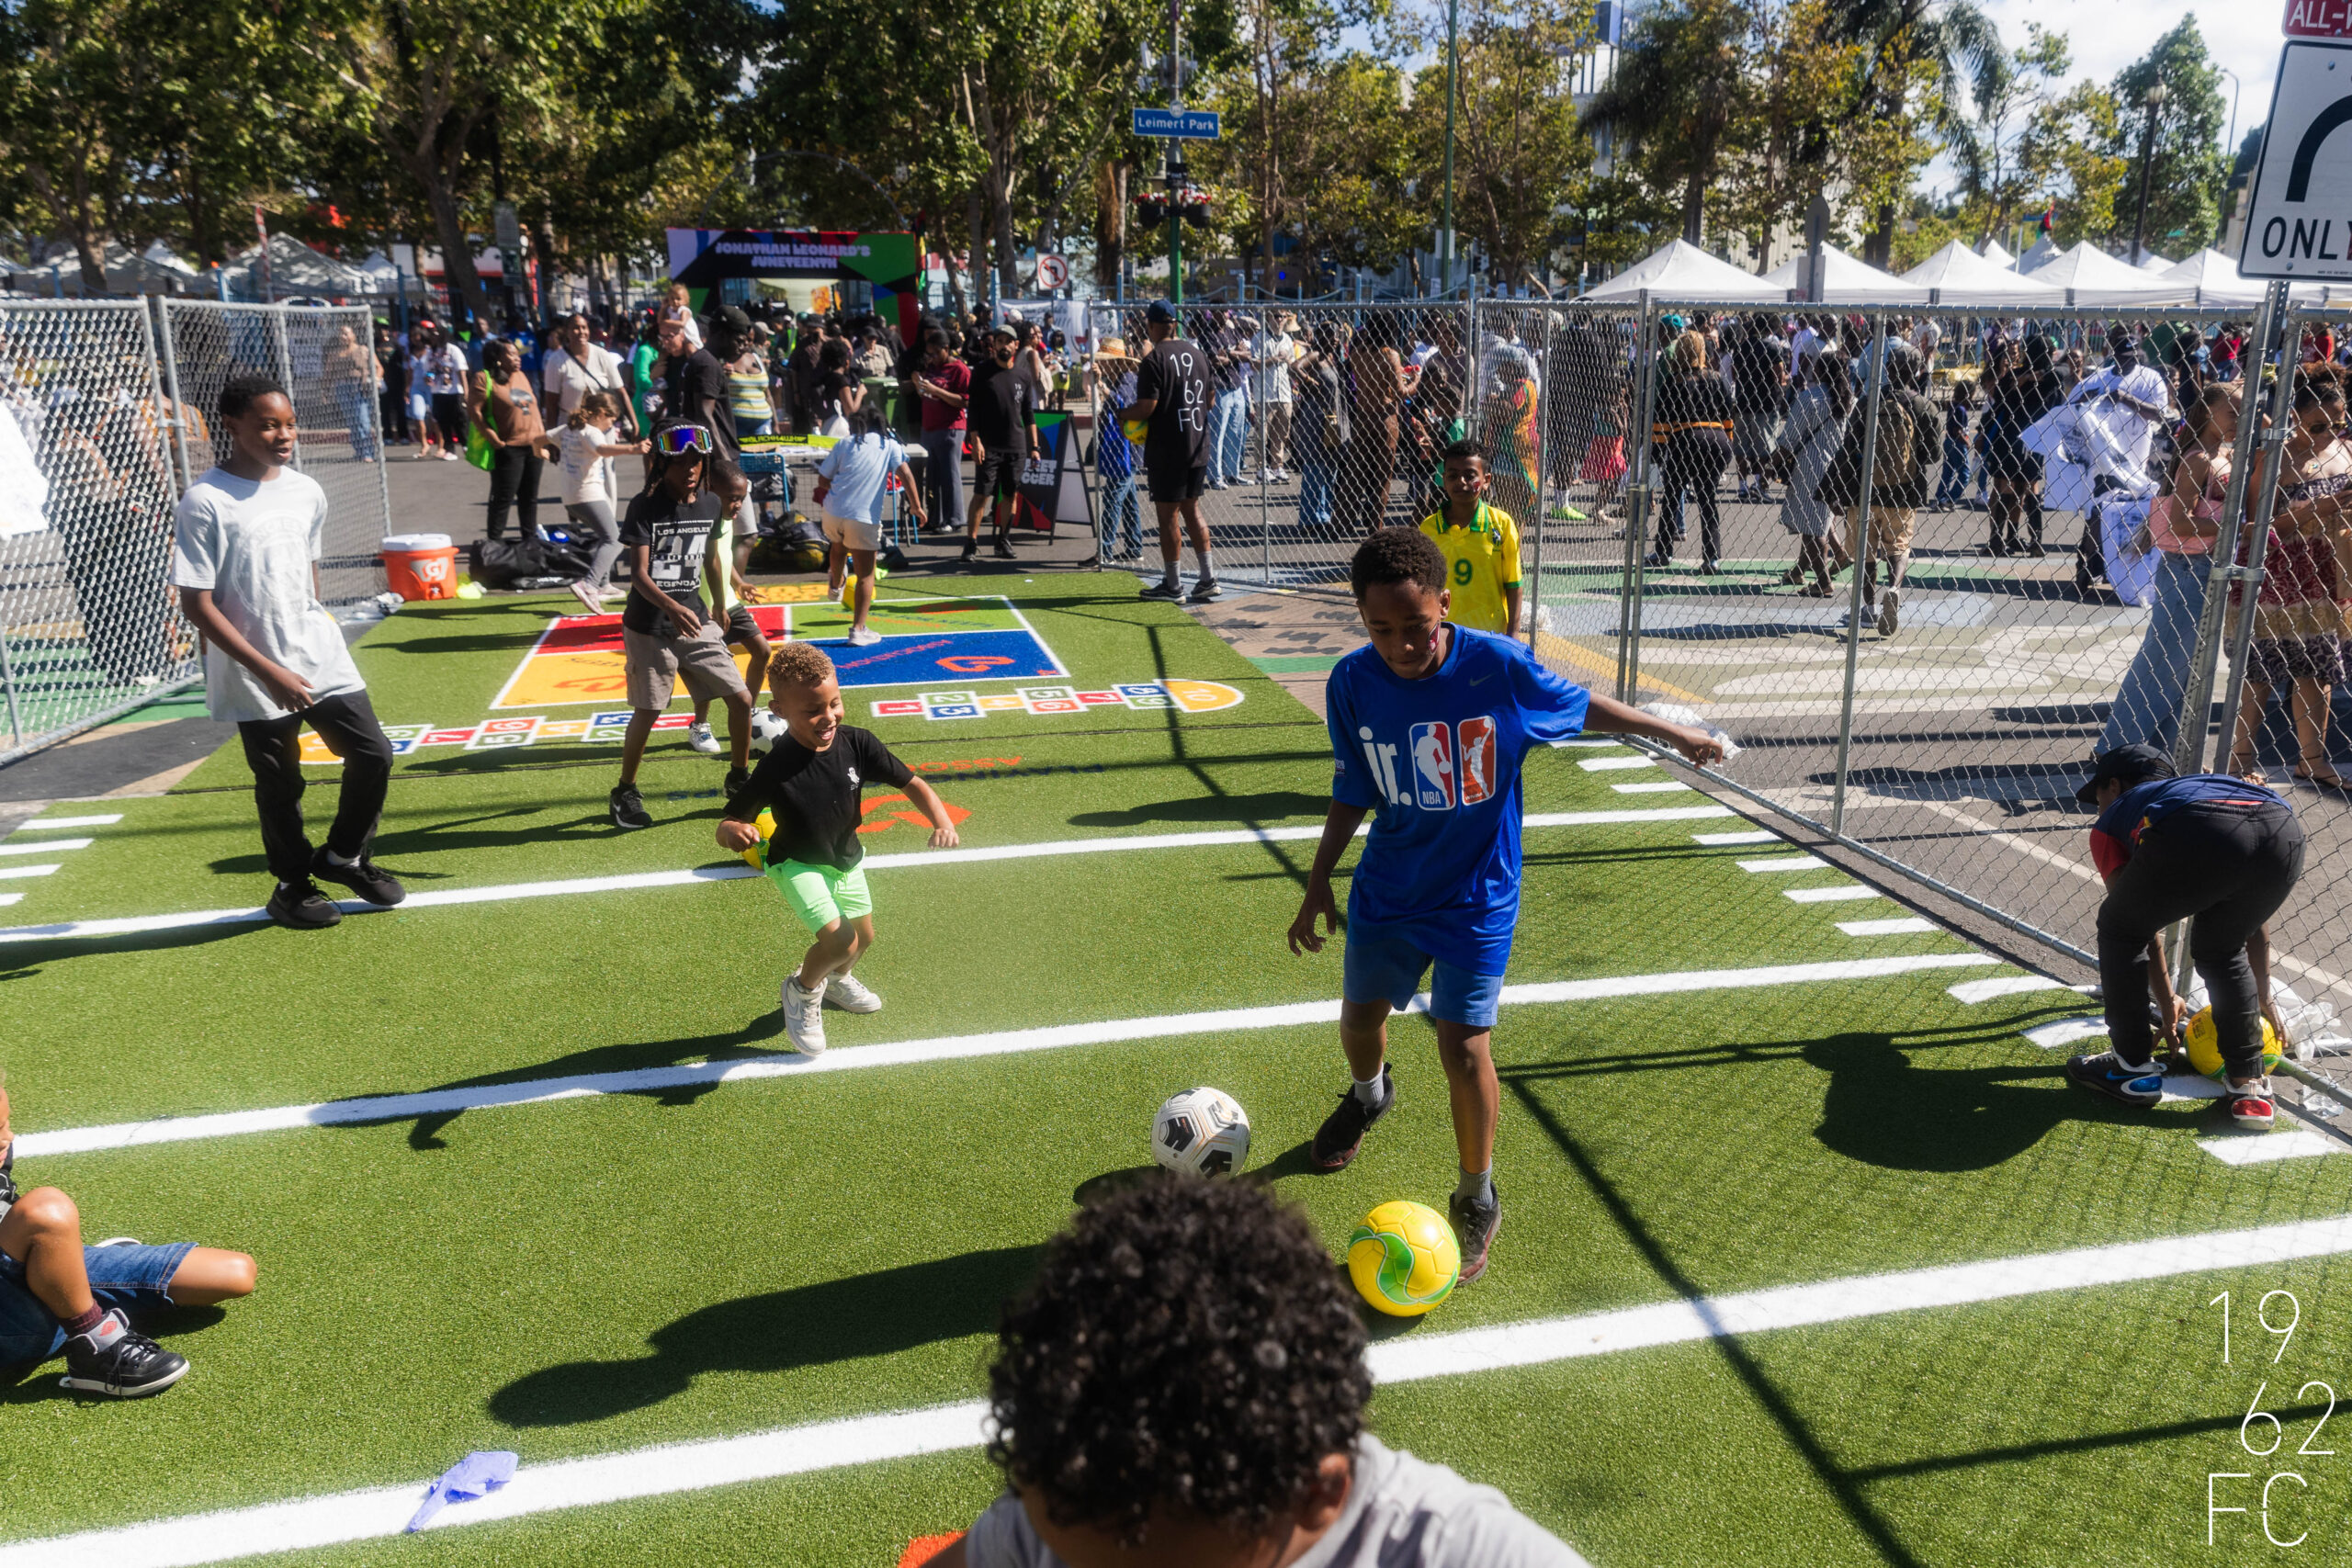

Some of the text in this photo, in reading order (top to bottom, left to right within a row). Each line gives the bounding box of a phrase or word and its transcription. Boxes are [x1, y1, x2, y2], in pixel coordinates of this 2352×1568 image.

[1138, 117, 1215, 130] Leimert Park
[715, 243, 871, 257] JONATHAN LEONARD'S
[2262, 216, 2352, 261] ONL
[751, 255, 838, 269] JUNETEENTH
[1170, 352, 1193, 378] 19
[1184, 378, 1204, 405] 62
[1177, 407, 1203, 433] FC
[1453, 558, 1474, 587] 9
[1359, 726, 1412, 807] jr.
[1422, 790, 1442, 806] NBA
